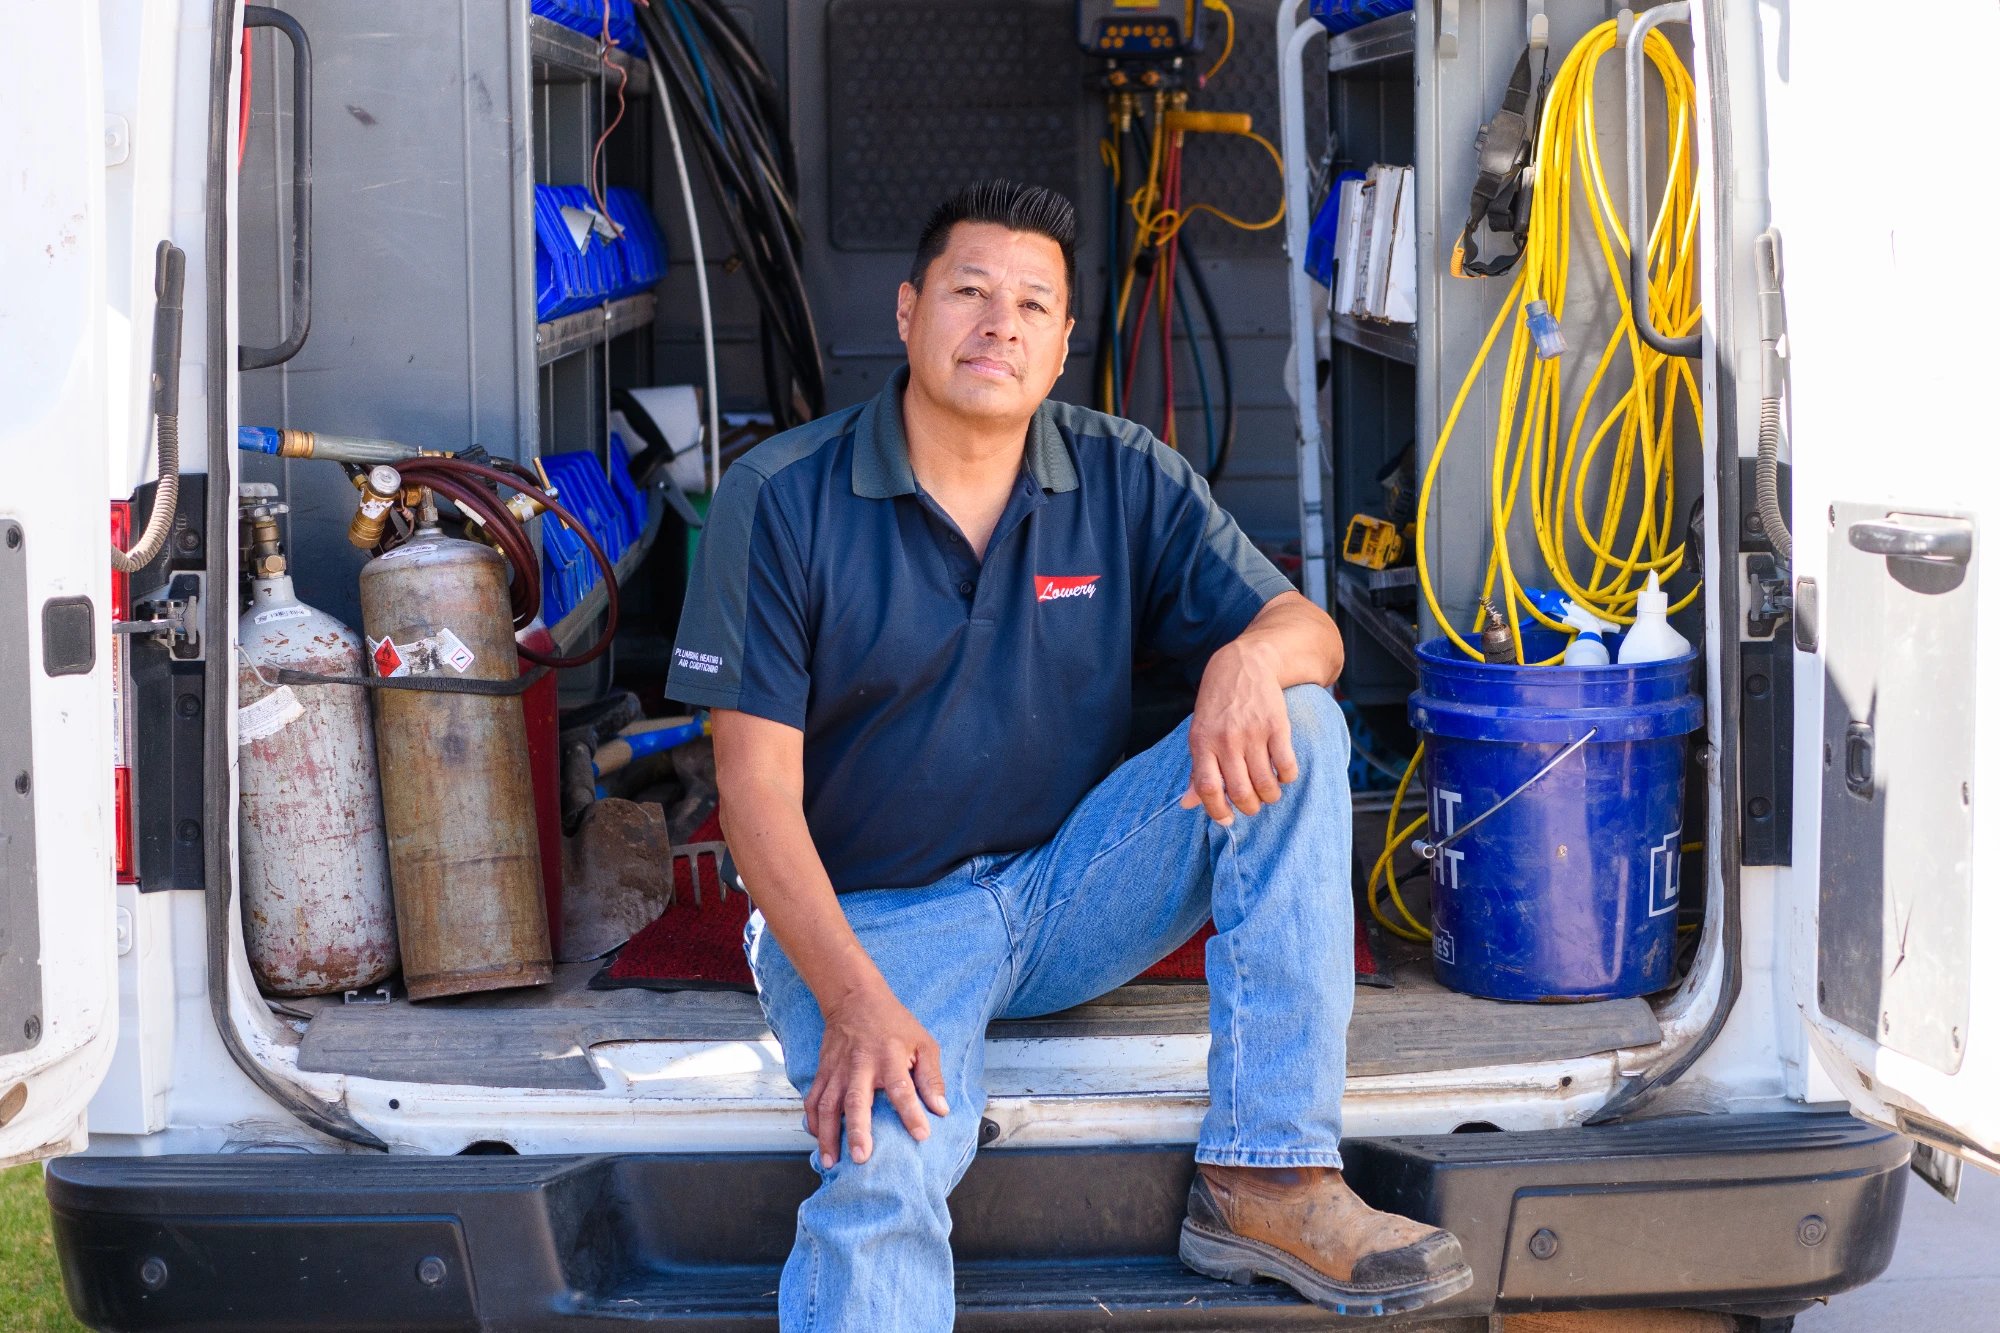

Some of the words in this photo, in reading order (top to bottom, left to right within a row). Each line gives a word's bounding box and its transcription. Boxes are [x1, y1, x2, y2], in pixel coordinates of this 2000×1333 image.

[1039, 581, 1097, 599] Lowery
[675, 647, 699, 662] PLUMBING
[700, 653, 719, 665] HEATING
[678, 658, 689, 668] AIR
[689, 660, 719, 674] CONDITIONING
[1433, 786, 1462, 837] IT
